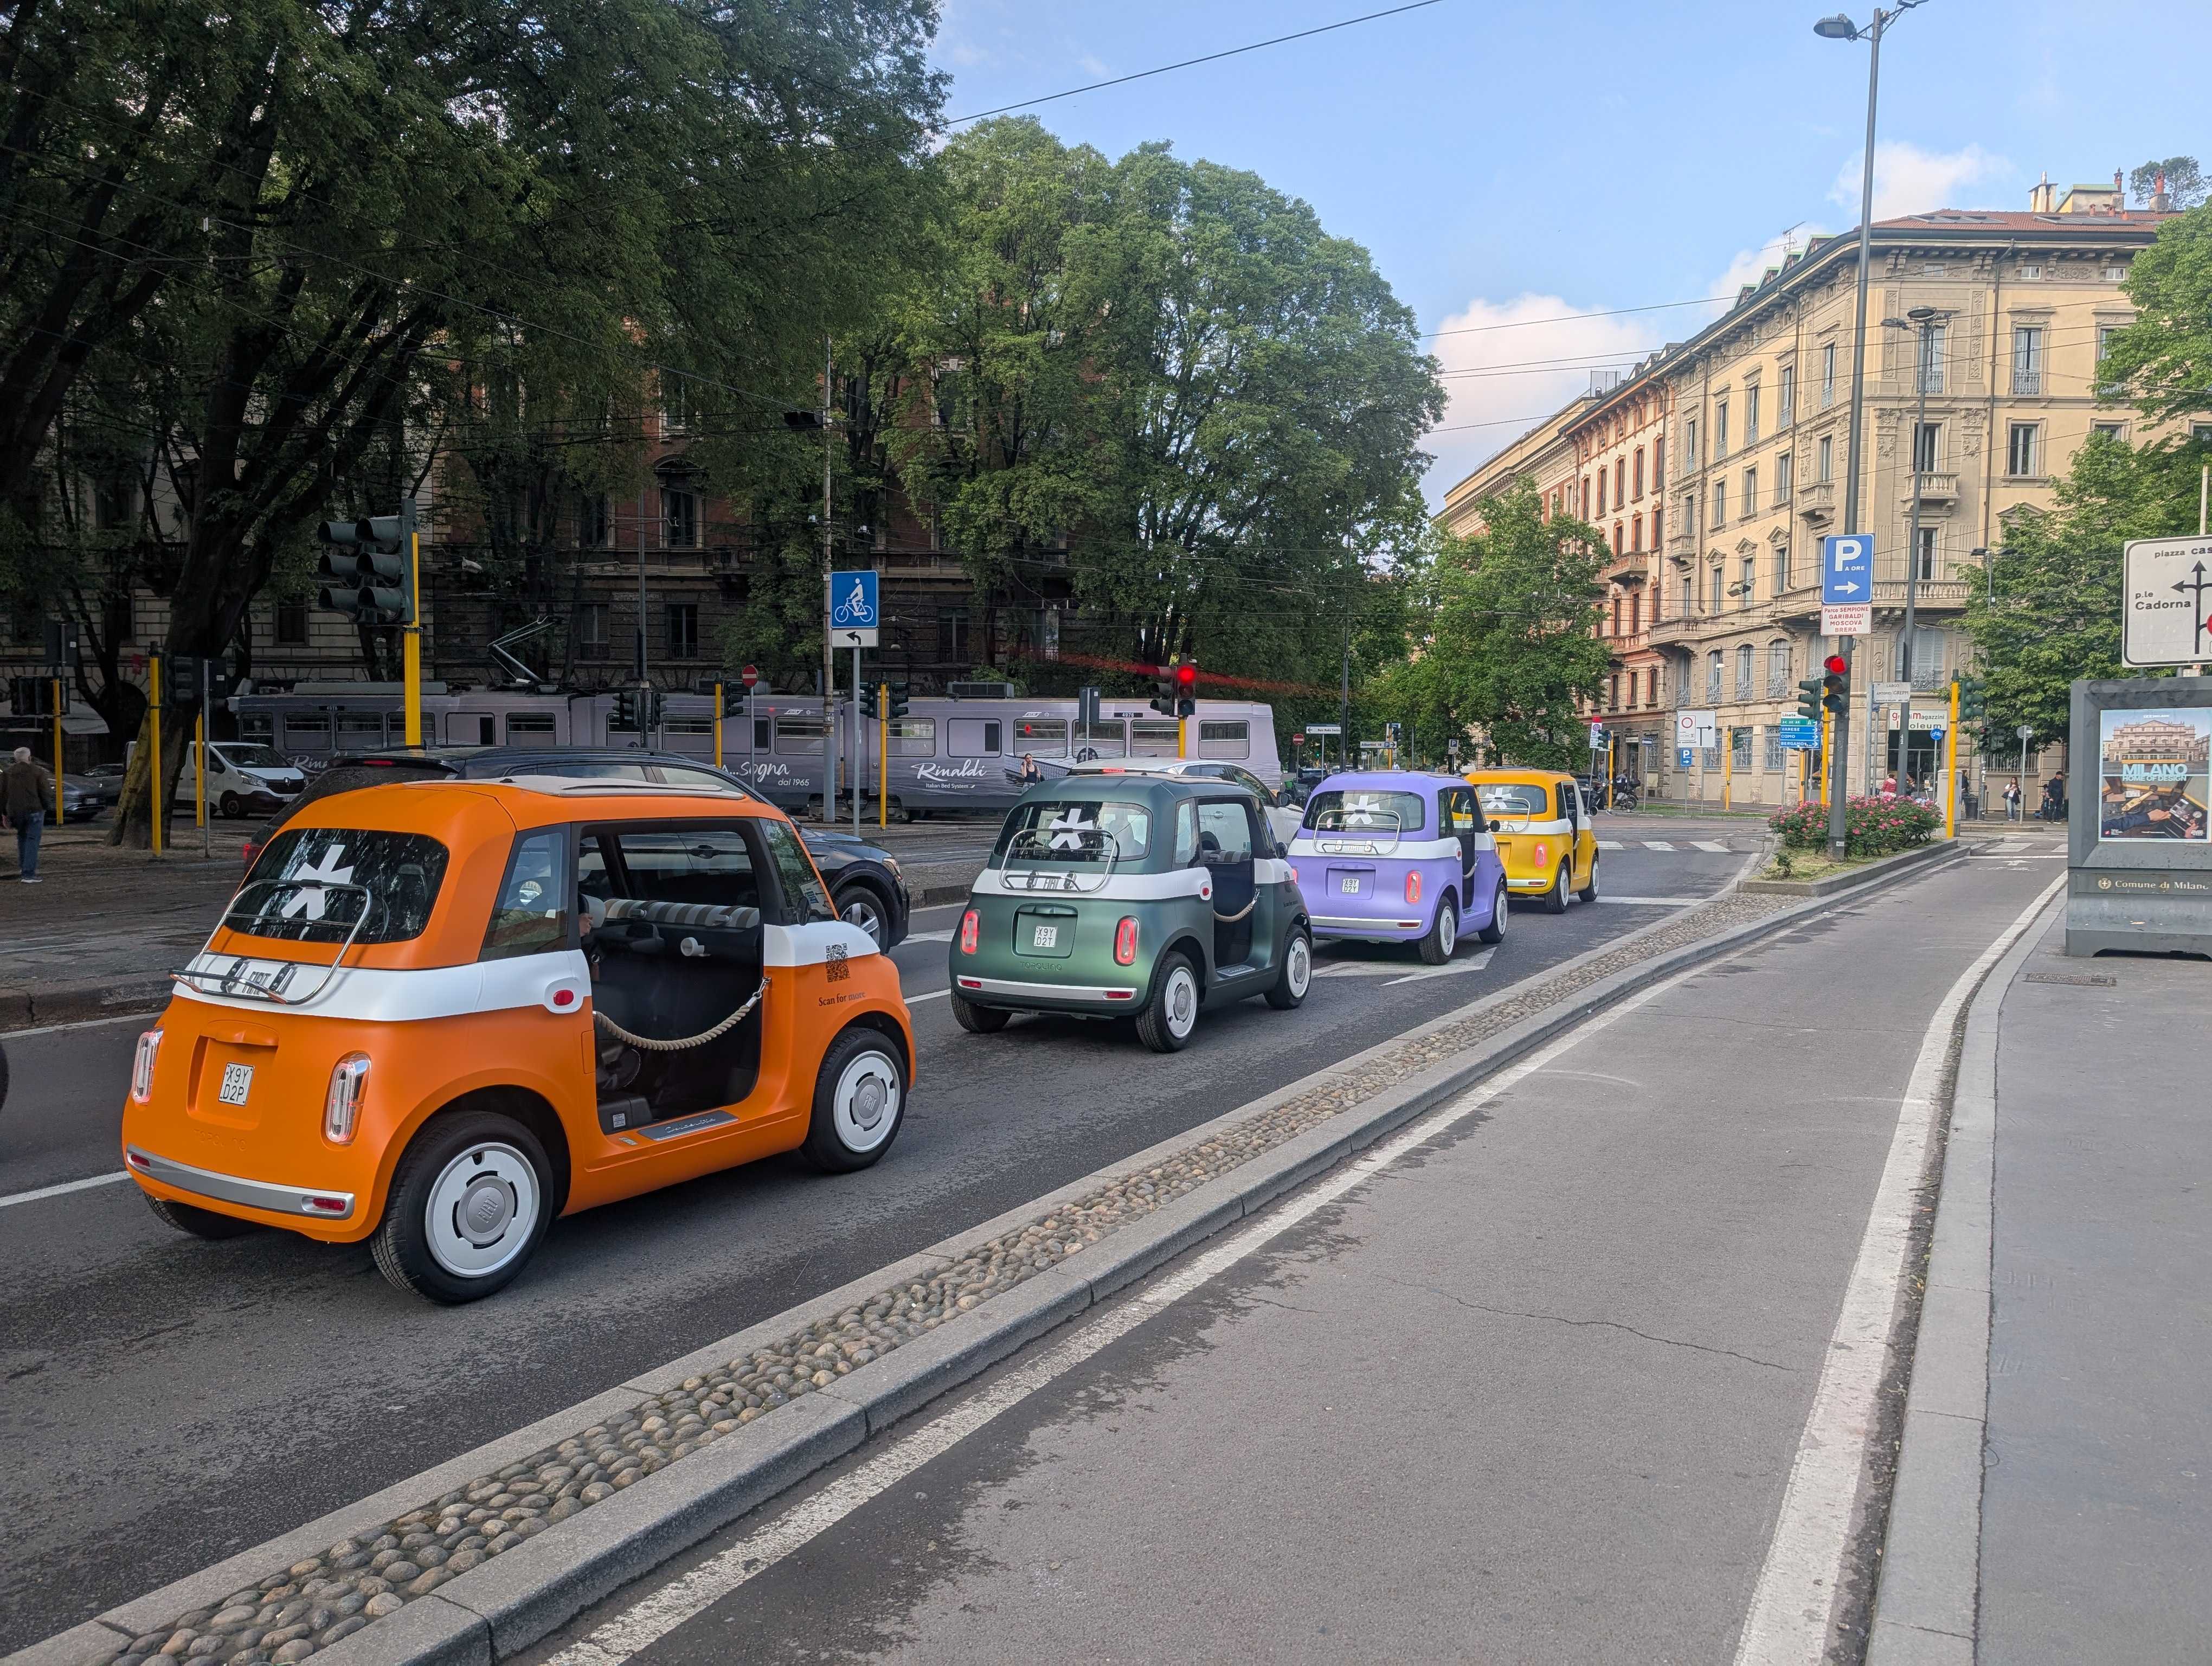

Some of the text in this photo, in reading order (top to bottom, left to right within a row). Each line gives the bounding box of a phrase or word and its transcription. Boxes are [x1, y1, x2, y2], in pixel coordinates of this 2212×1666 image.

[1835, 539, 1862, 572] P
[2155, 550, 2185, 559] piazza
[2135, 591, 2153, 599] p.le
[2136, 600, 2191, 610] Cadorna
[1892, 712, 1912, 721] gri
[1896, 721, 1941, 729] loleum
[1683, 750, 1690, 758] P
[911, 759, 987, 781] Rinaldi
[2123, 764, 2188, 775] MILANO
[778, 778, 791, 786] dal
[2115, 880, 2156, 888] Comune
[1037, 927, 1054, 937] X9Y
[1036, 937, 1053, 946] D2T
[819, 992, 866, 1007] Scan for more
[227, 1066, 249, 1085] X9Y
[222, 1084, 244, 1102] D2P
